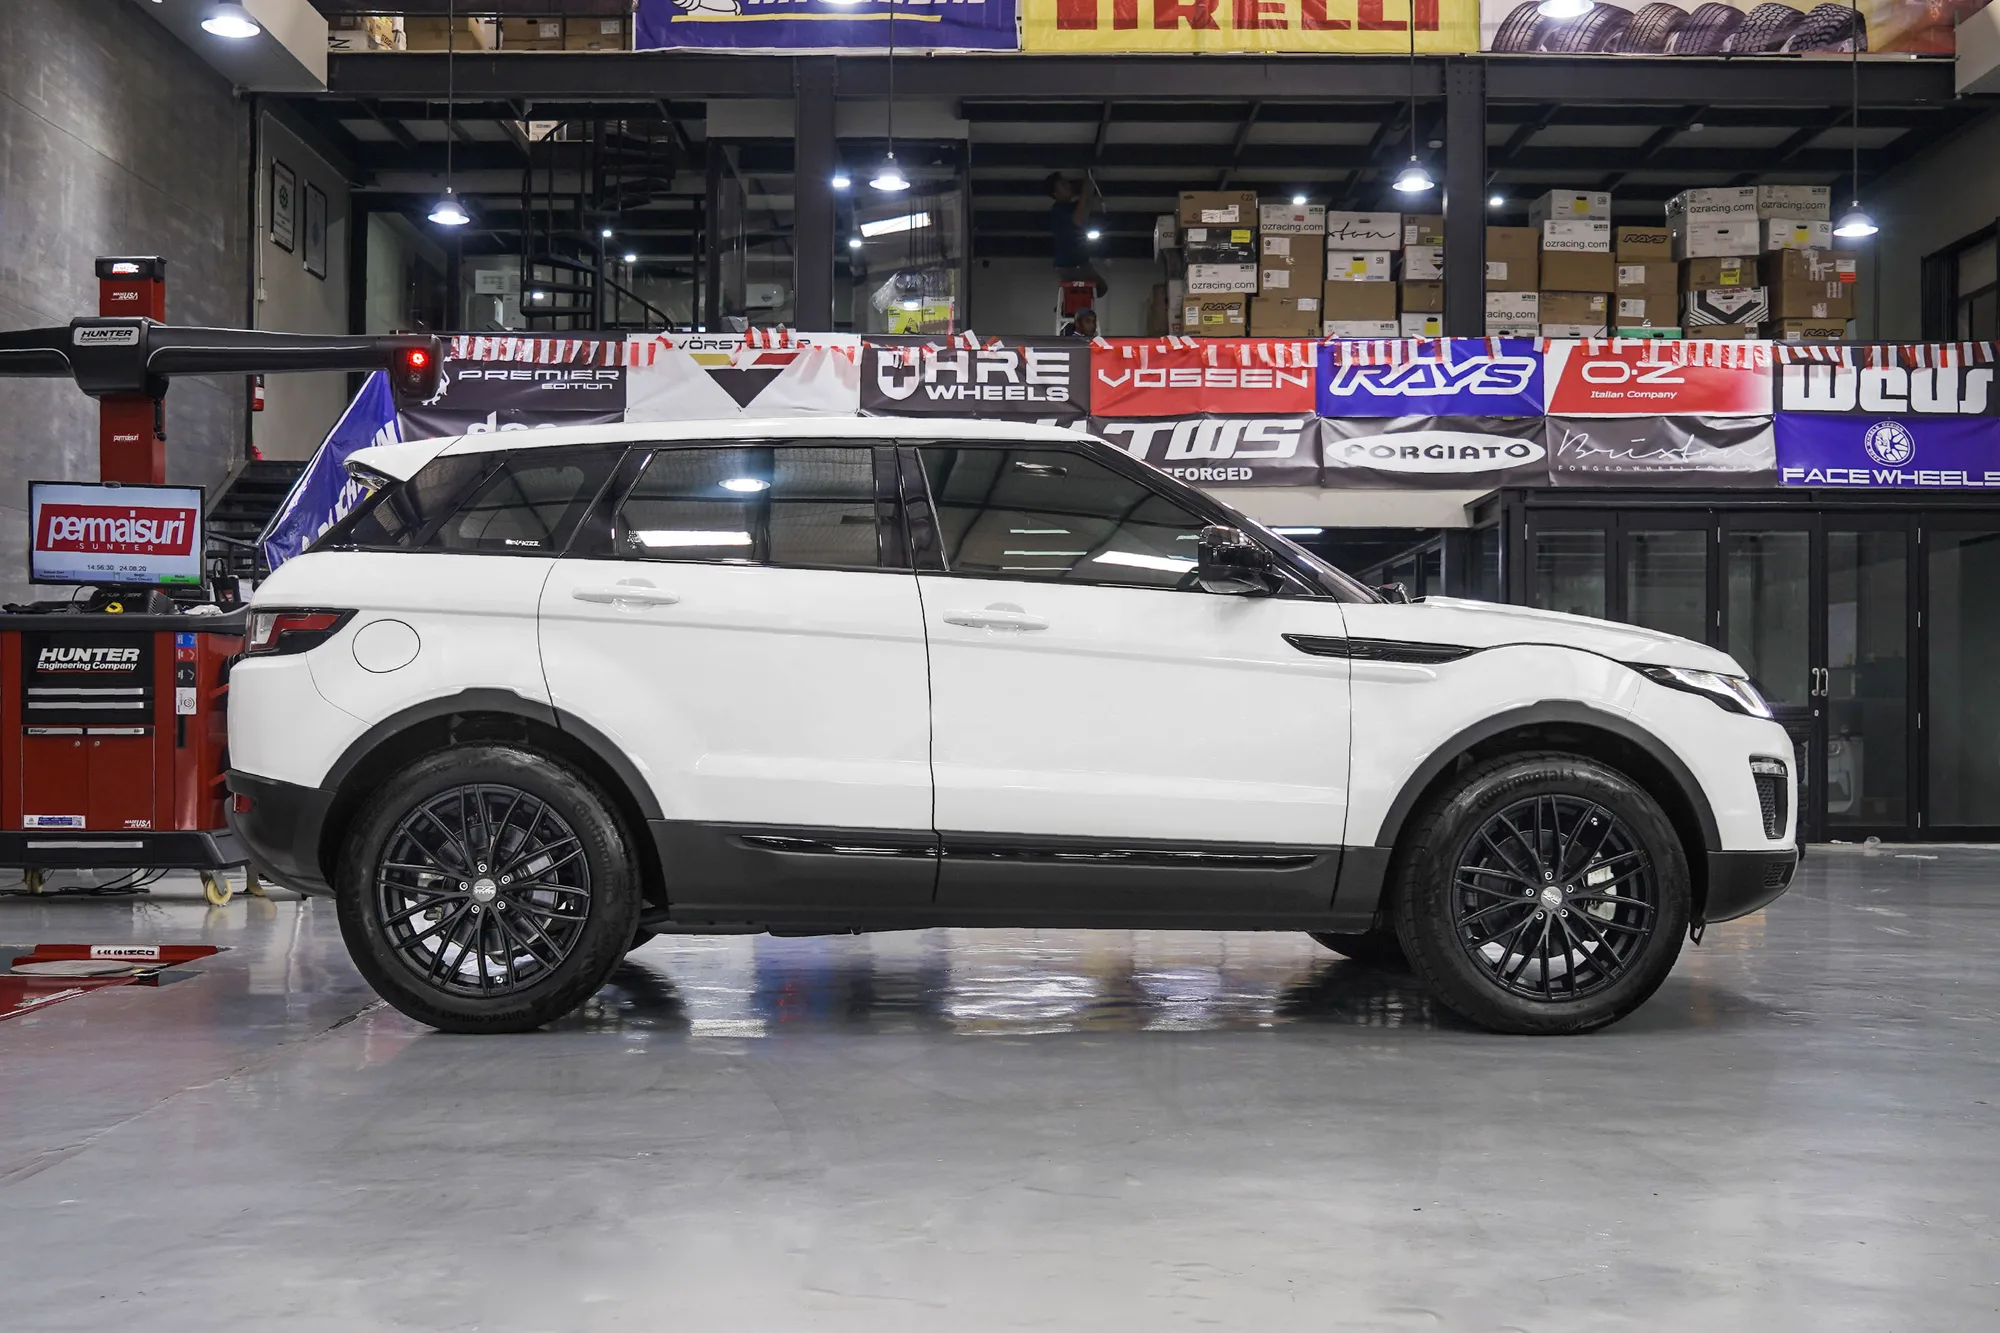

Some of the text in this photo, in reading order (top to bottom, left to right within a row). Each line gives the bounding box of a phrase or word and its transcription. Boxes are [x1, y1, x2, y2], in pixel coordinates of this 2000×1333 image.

[1690, 202, 1754, 214] ozracing.com
[1761, 200, 1826, 211] ozracing.com
[1261, 223, 1324, 233] ozracing.com
[1545, 239, 1608, 250] ozracing.com
[1623, 234, 1668, 244] RAYS
[1191, 280, 1255, 291] ozracing.com
[1201, 302, 1242, 311] RAYS
[1486, 309, 1536, 320] acing.com
[1803, 328, 1844, 337] RAYS
[924, 350, 1070, 385] HRE
[458, 370, 620, 381] PREMIER
[1098, 368, 1308, 389] VOSSEN
[1329, 355, 1537, 396] RAYS
[924, 385, 1070, 402] WHEELS
[1590, 391, 1677, 400] Italian Company
[1103, 419, 1305, 461] TWS
[1344, 444, 1531, 460] FORGIATO
[1782, 467, 2000, 486] FACE WHEELS
[47, 510, 186, 548] permaisuri
[79, 542, 154, 551] SUNTER
[38, 648, 141, 662] HUNTER
[37, 661, 138, 671] Engineering Company
[135, 820, 151, 828] USA
